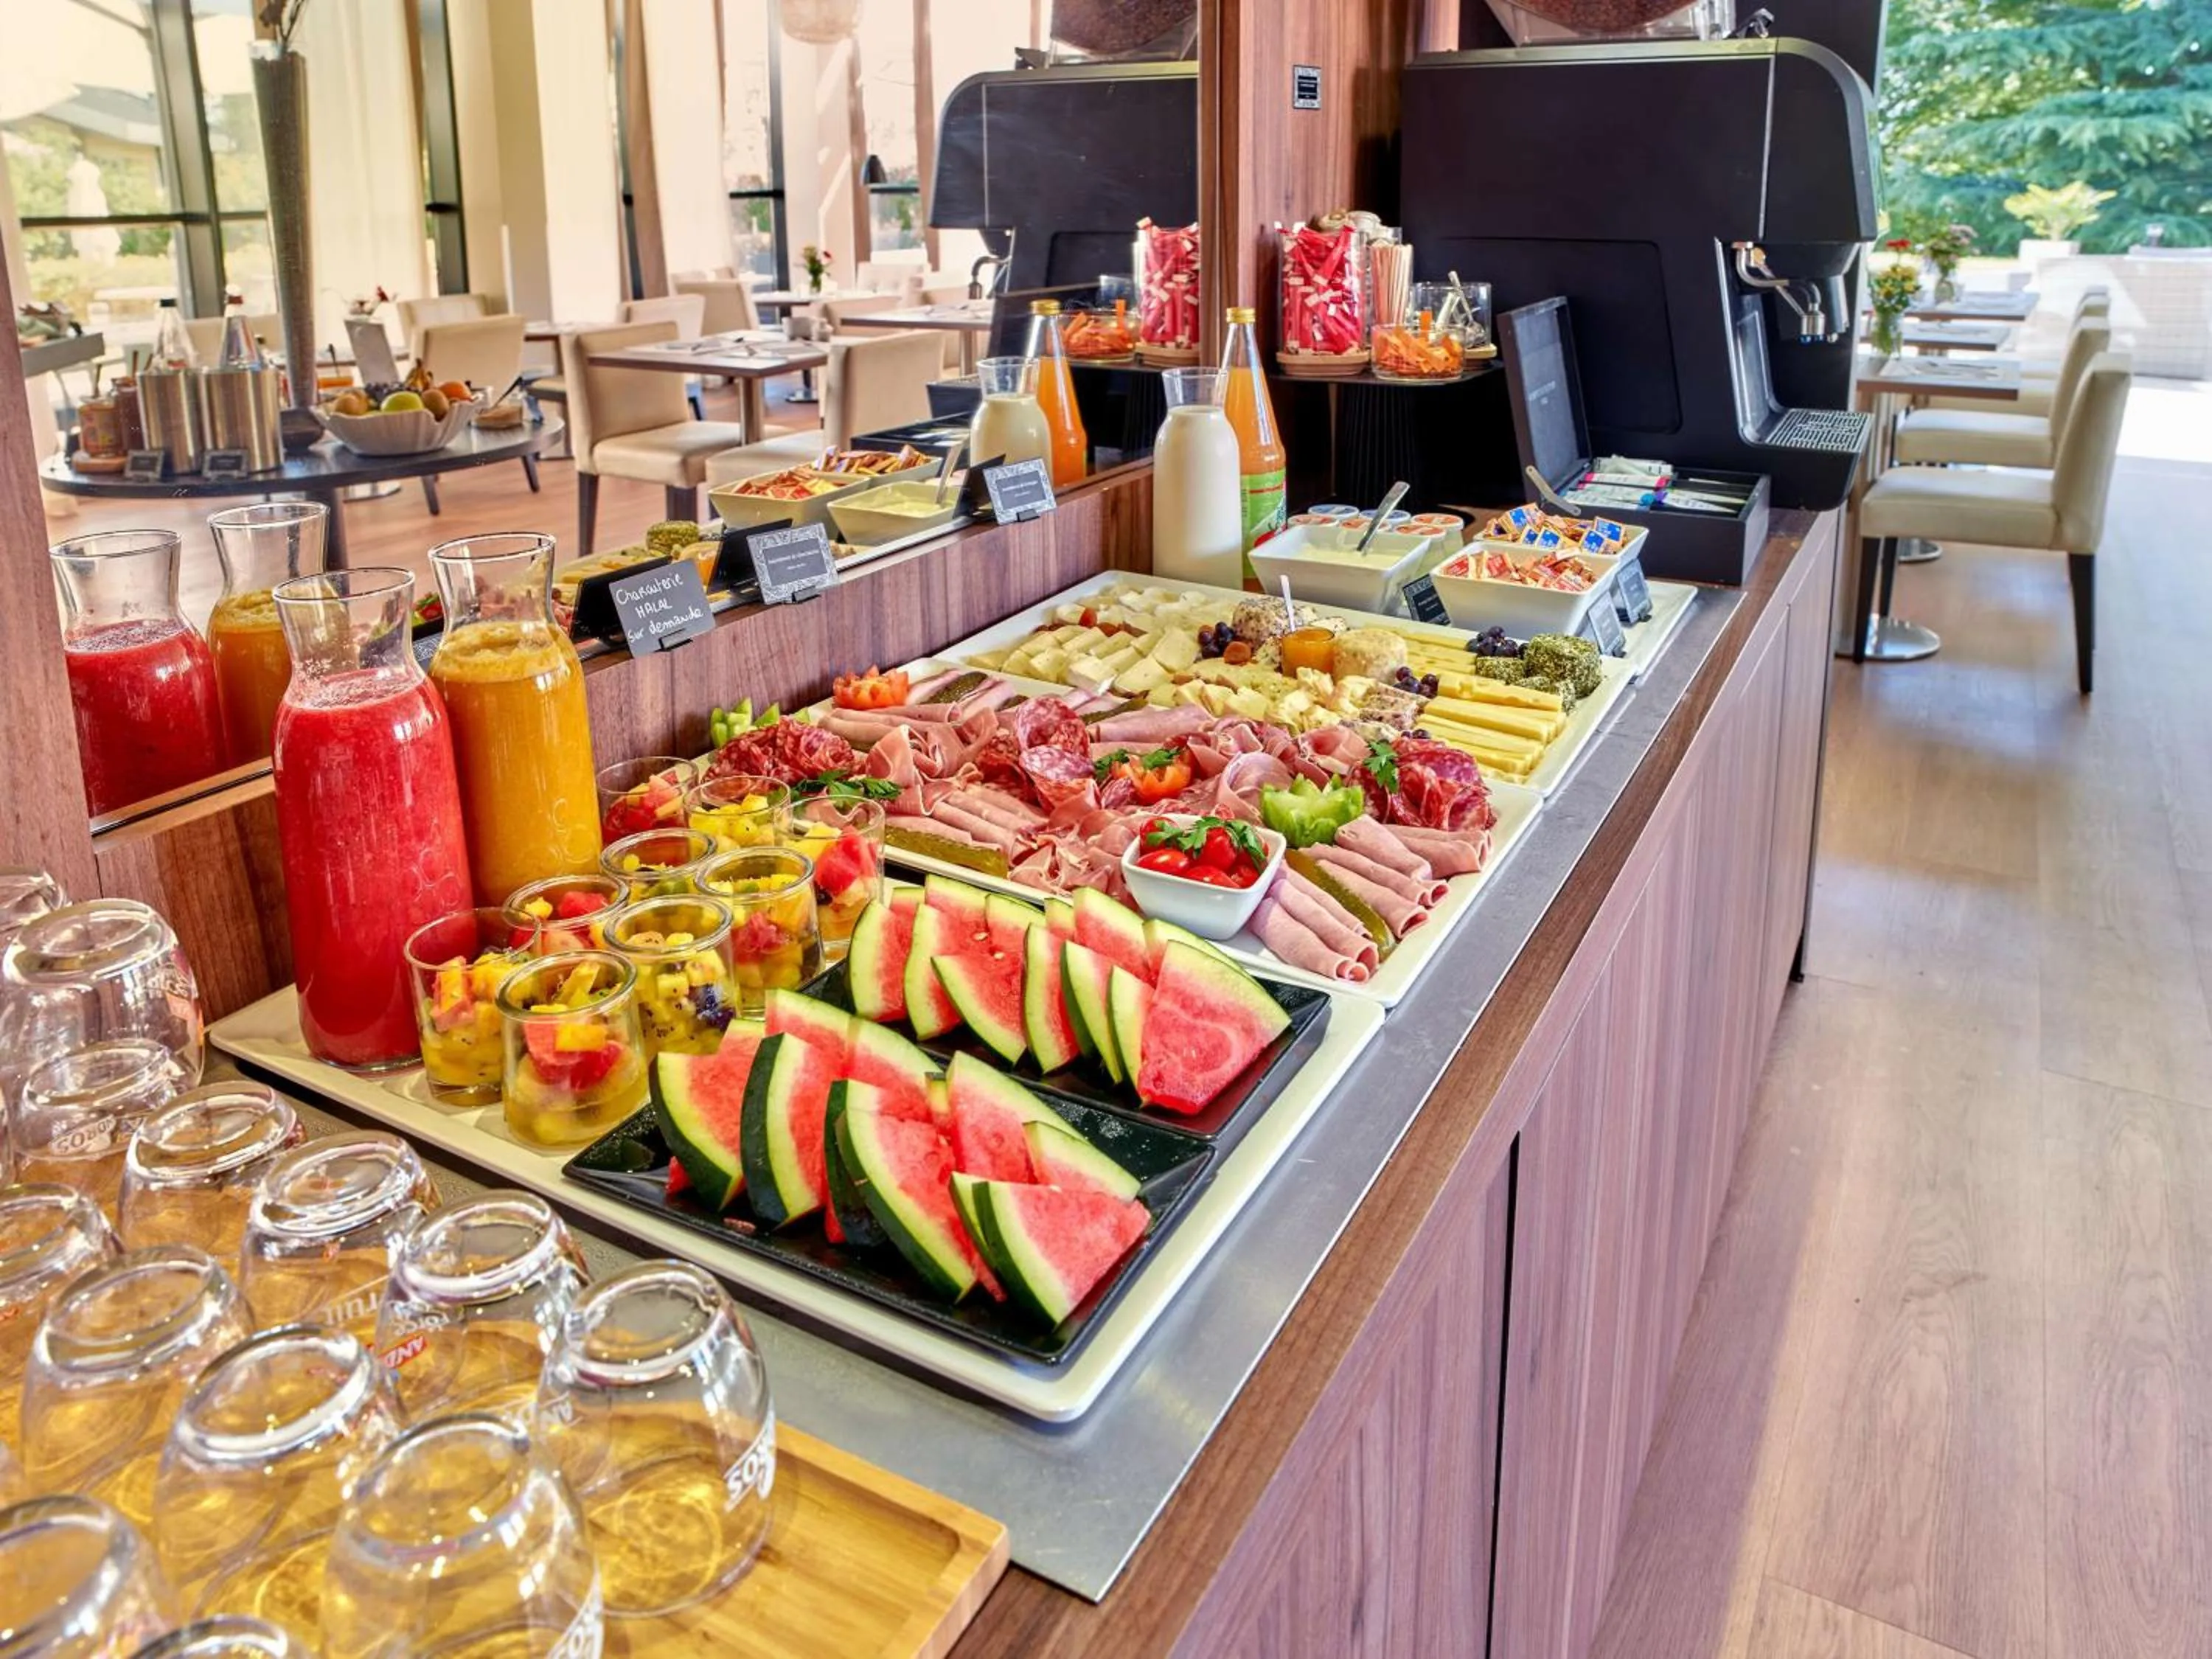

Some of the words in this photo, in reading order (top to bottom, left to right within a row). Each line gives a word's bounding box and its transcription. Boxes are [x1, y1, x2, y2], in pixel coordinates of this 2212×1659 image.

[616, 573, 684, 605] Charcuterie
[635, 598, 672, 619] HALAL
[649, 605, 704, 634] demande
[323, 1292, 378, 1325] ruit
[385, 1335, 425, 1368] AND
